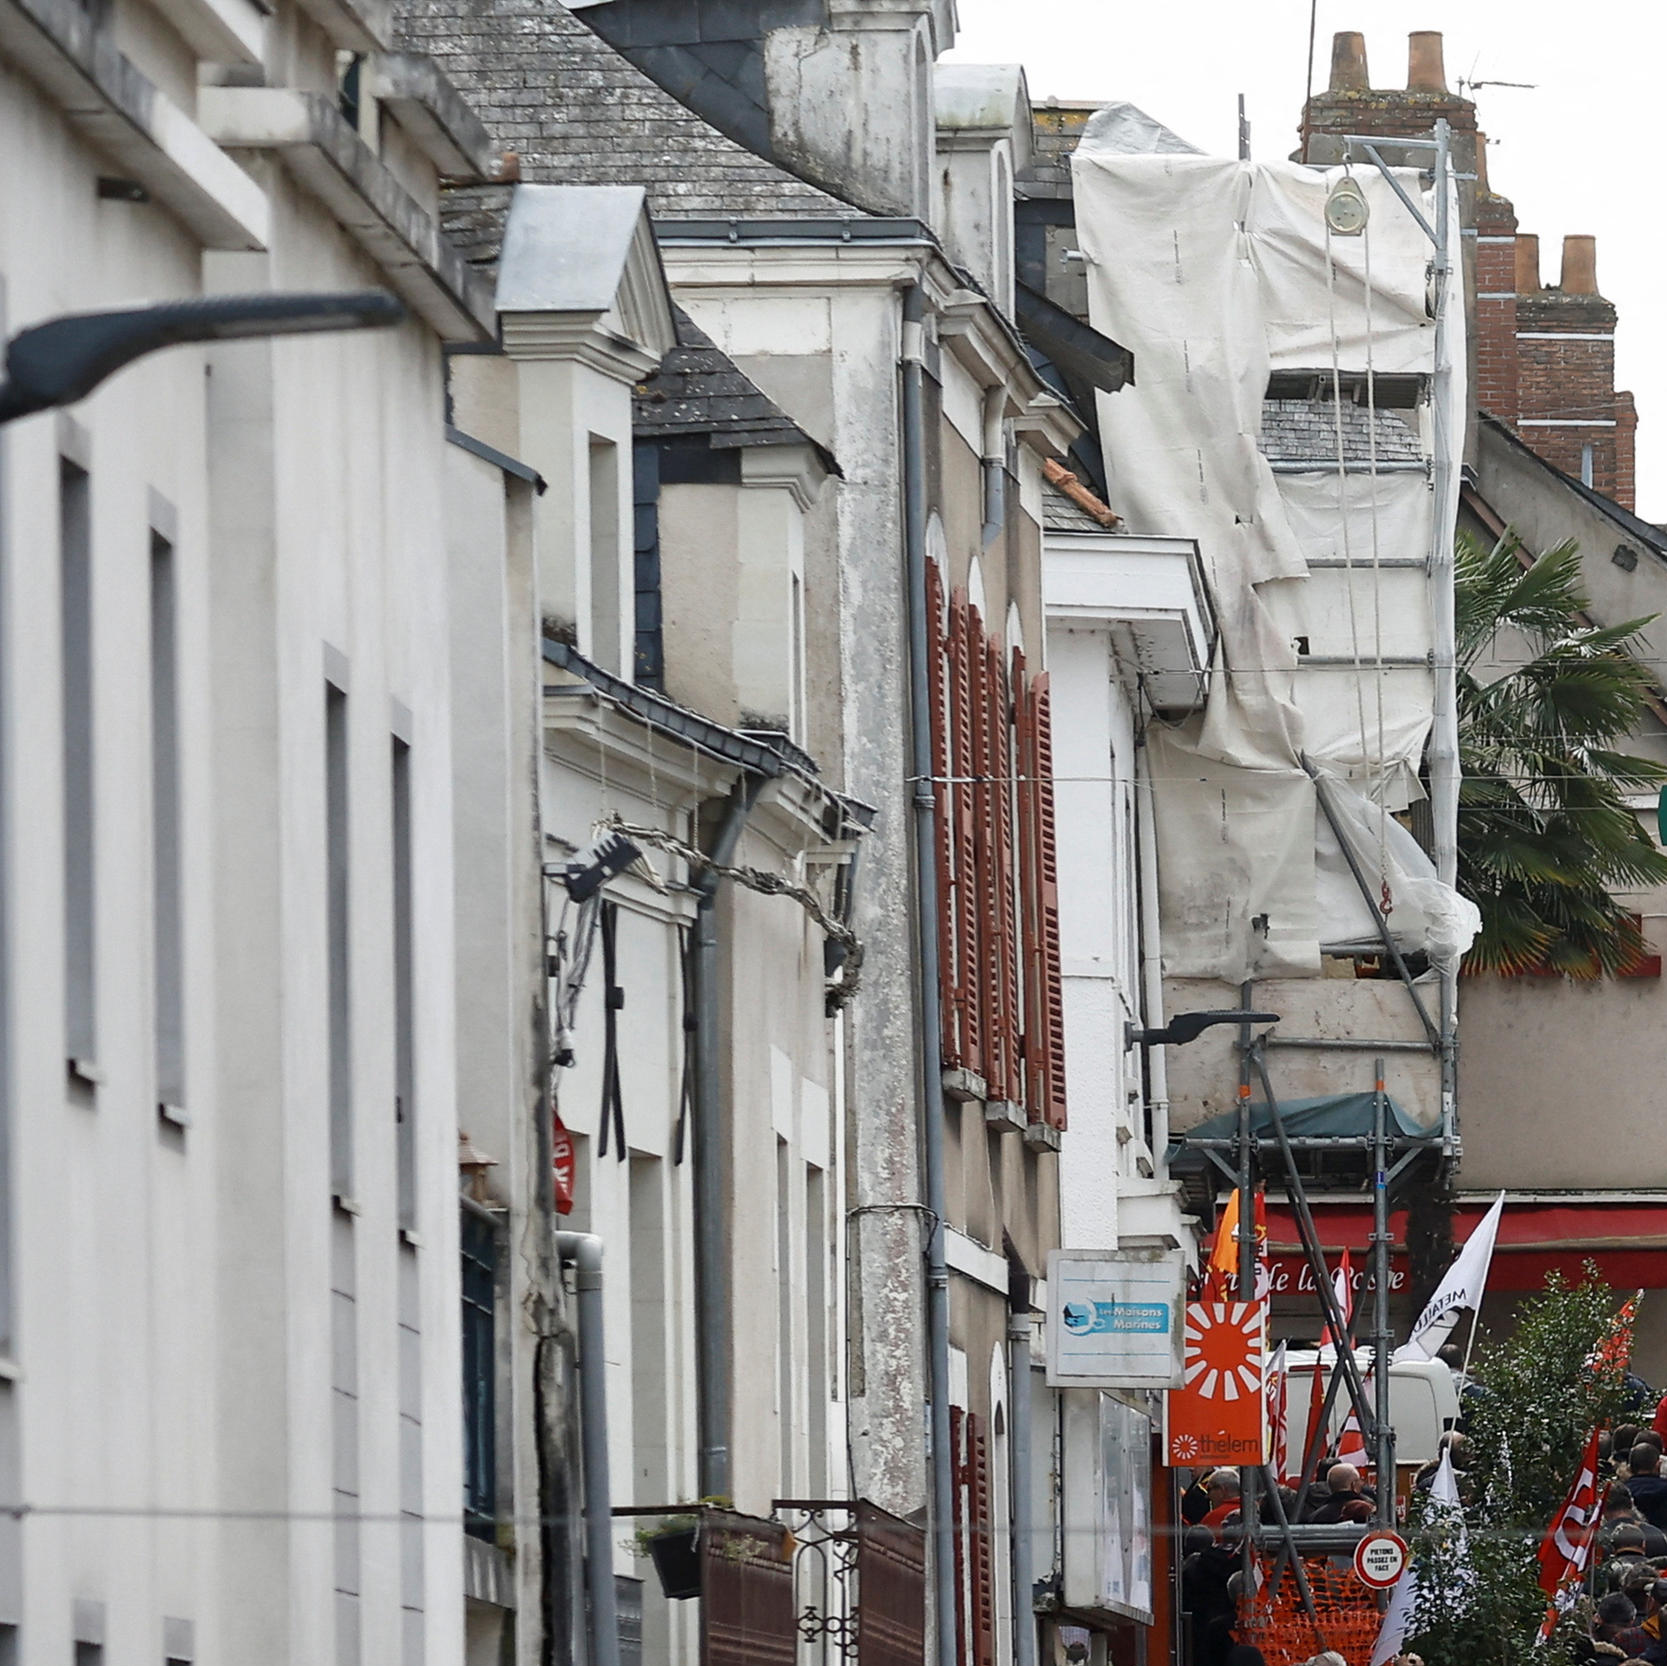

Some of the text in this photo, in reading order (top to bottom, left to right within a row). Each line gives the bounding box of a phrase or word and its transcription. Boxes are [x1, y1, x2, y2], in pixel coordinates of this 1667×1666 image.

[1113, 1307, 1164, 1318] Maisons
[1112, 1318, 1162, 1330] Marines
[1199, 1429, 1260, 1454] thélem
[1367, 1556, 1389, 1564] PASSEZ
